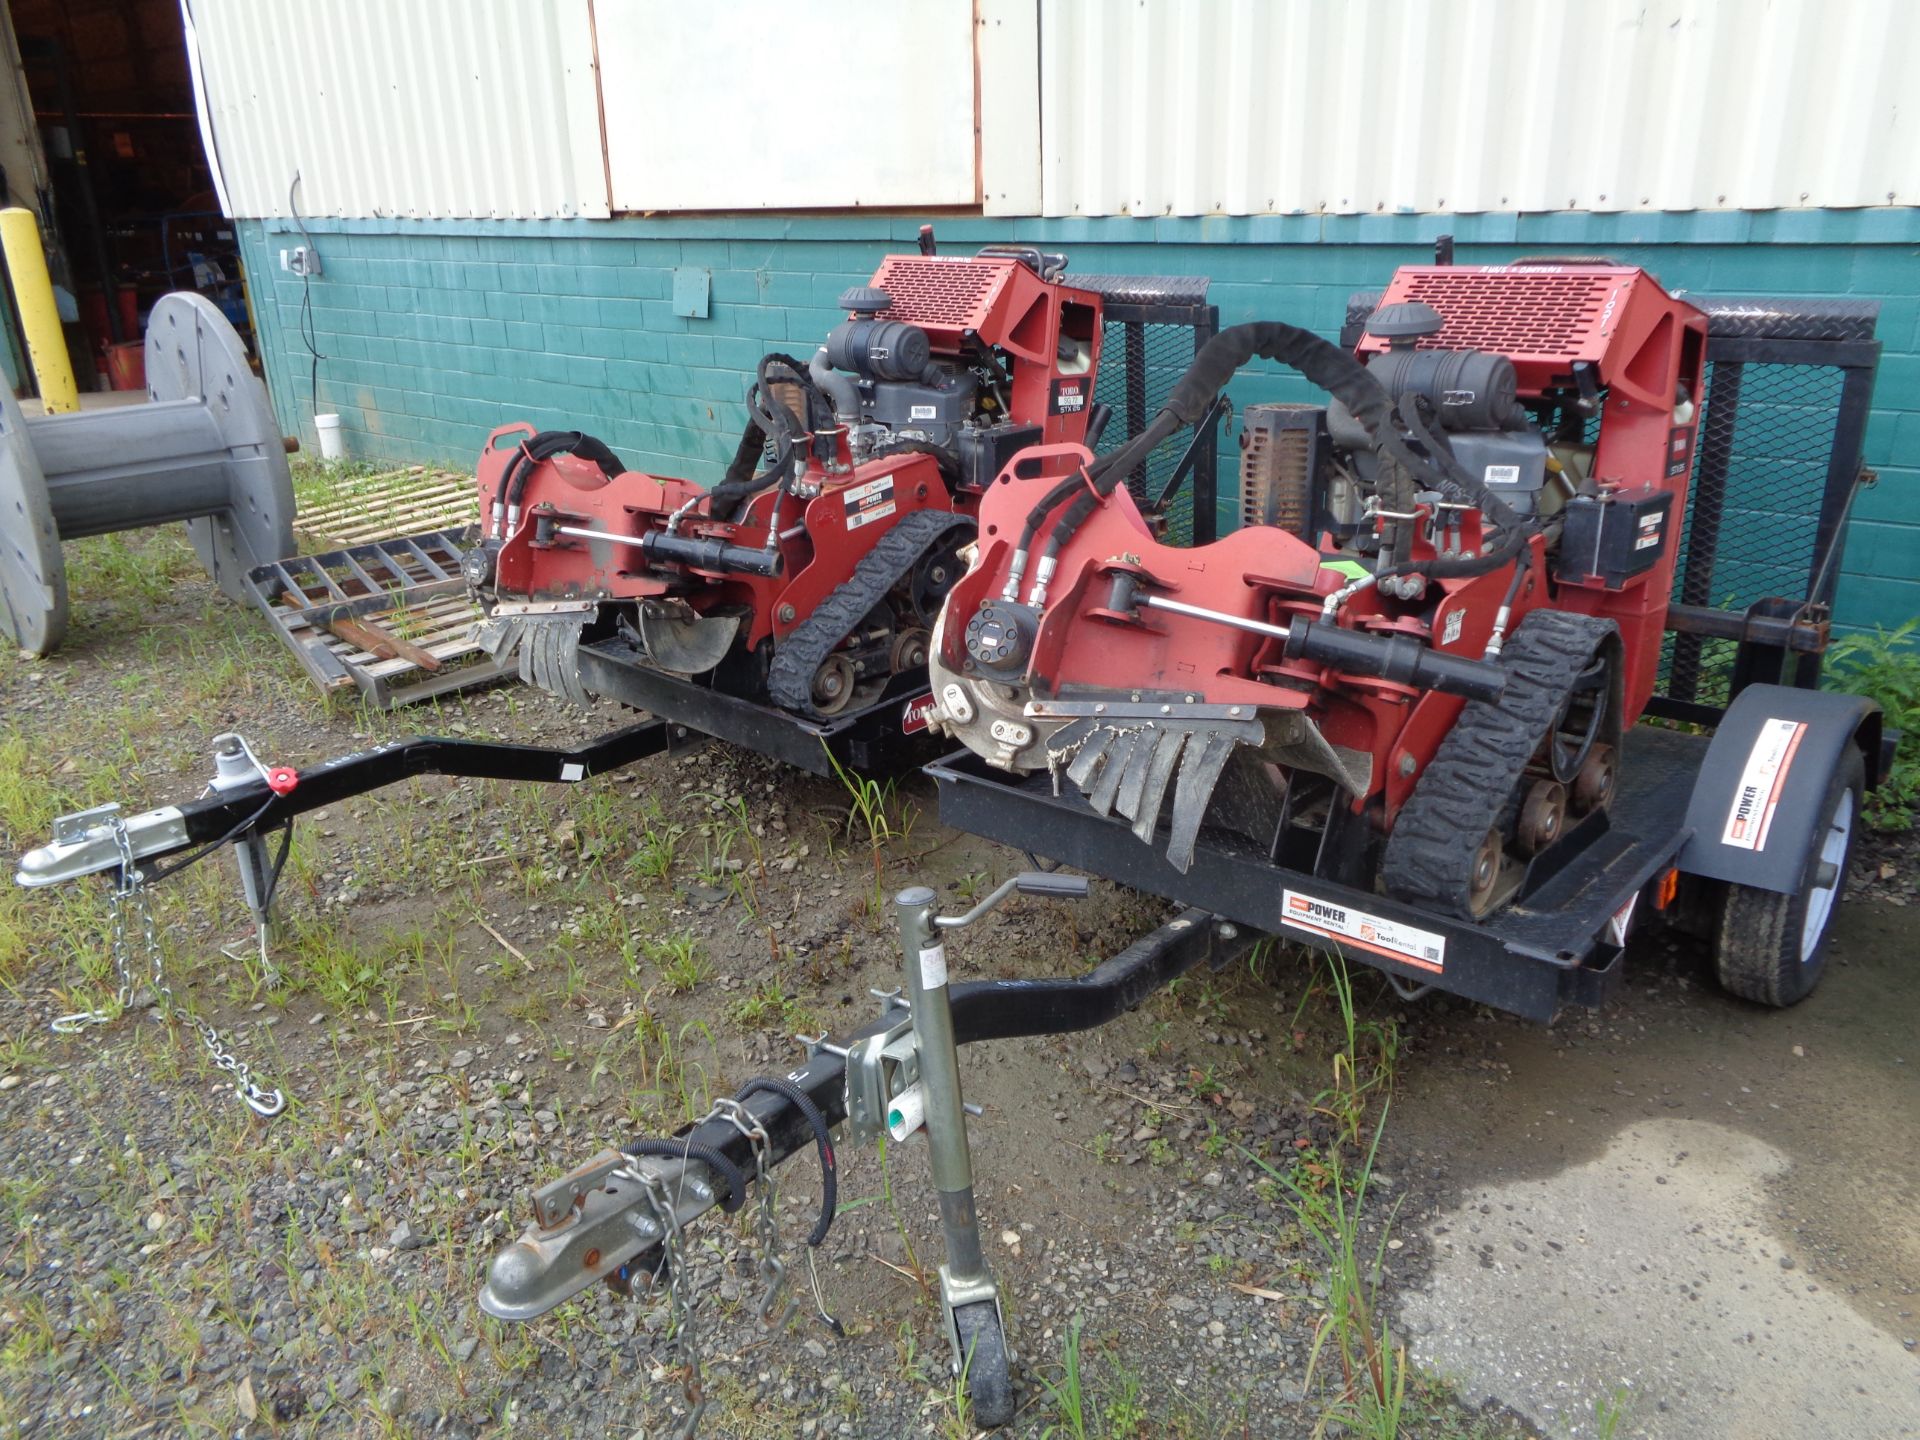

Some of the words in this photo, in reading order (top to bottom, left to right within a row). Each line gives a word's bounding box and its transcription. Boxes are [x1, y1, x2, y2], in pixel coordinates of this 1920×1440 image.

[1735, 785, 1757, 822] POWER
[1289, 908, 1322, 923] EQUIPMENT
[1323, 918, 1345, 930] RENTAL
[1308, 902, 1346, 923] POWER
